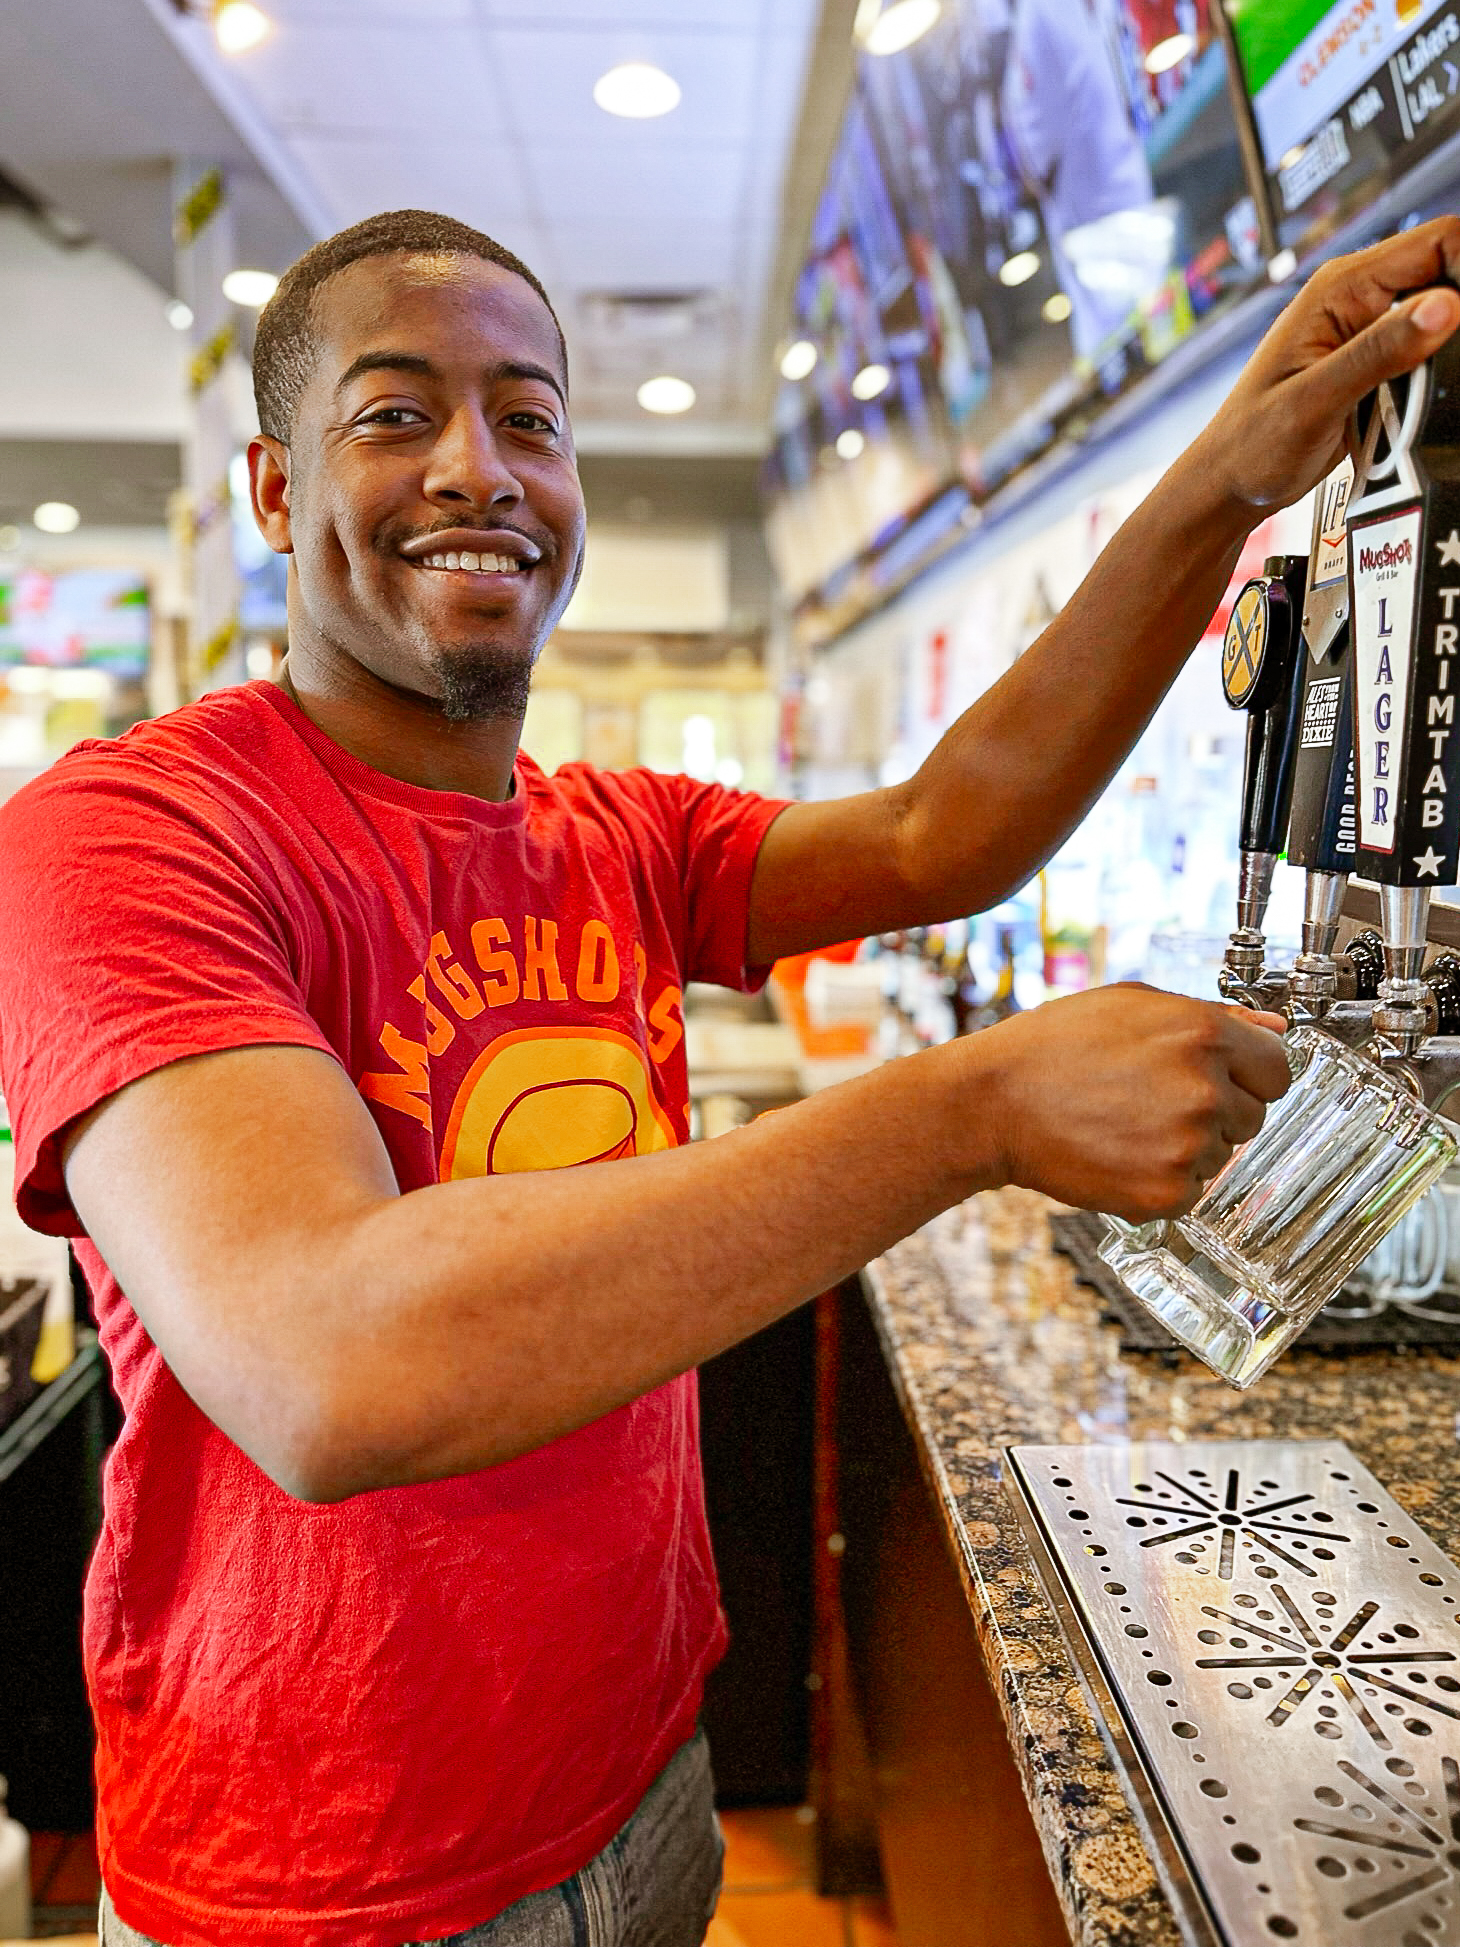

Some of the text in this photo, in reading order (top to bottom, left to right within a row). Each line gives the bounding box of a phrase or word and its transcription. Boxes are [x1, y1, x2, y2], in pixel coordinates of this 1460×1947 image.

[1322, 475, 1350, 534] IP
[1323, 557, 1344, 570] DRAFT
[1306, 684, 1327, 704] ALES
[1304, 702, 1329, 721] HEART
[1371, 597, 1394, 826] LAGER
[1301, 724, 1335, 743] DIXIE
